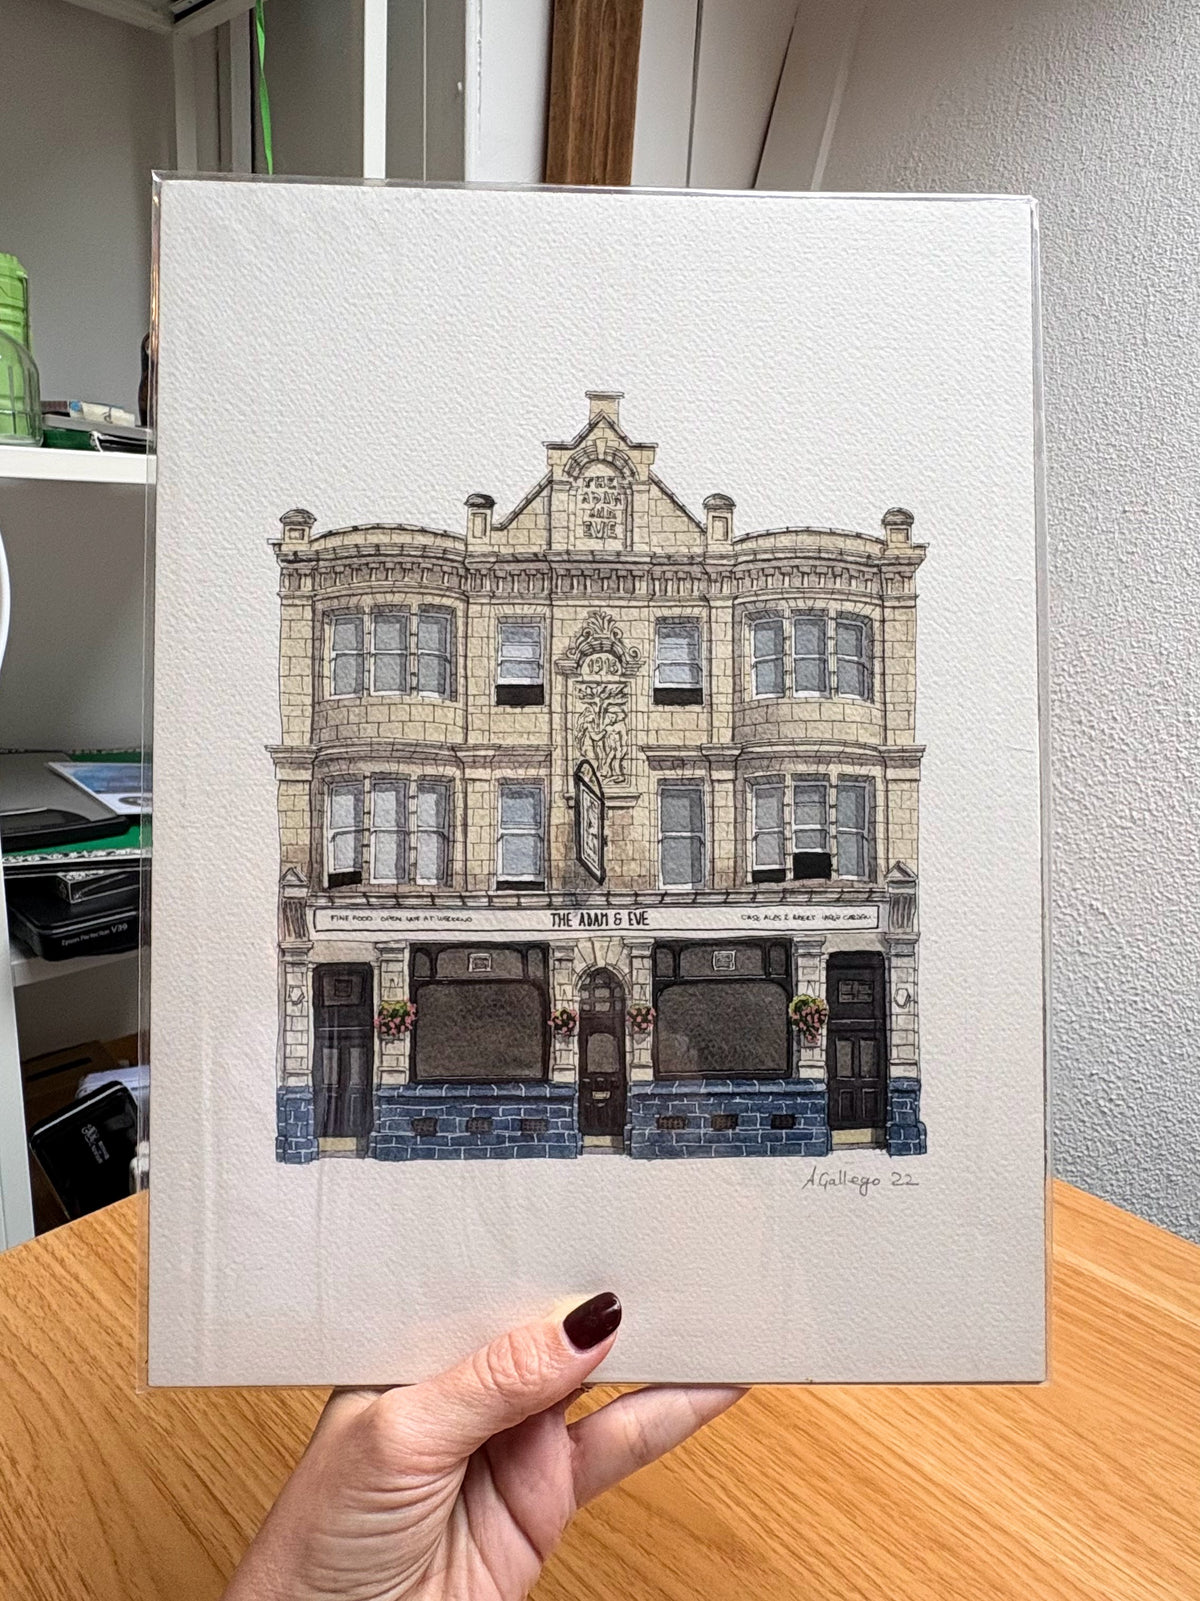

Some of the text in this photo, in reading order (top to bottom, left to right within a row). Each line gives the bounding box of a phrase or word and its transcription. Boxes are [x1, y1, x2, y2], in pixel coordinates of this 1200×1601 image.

[583, 520, 617, 539] EVE
[549, 910, 650, 928] THE ADAM & EVE
[890, 1171, 919, 1186] 22
